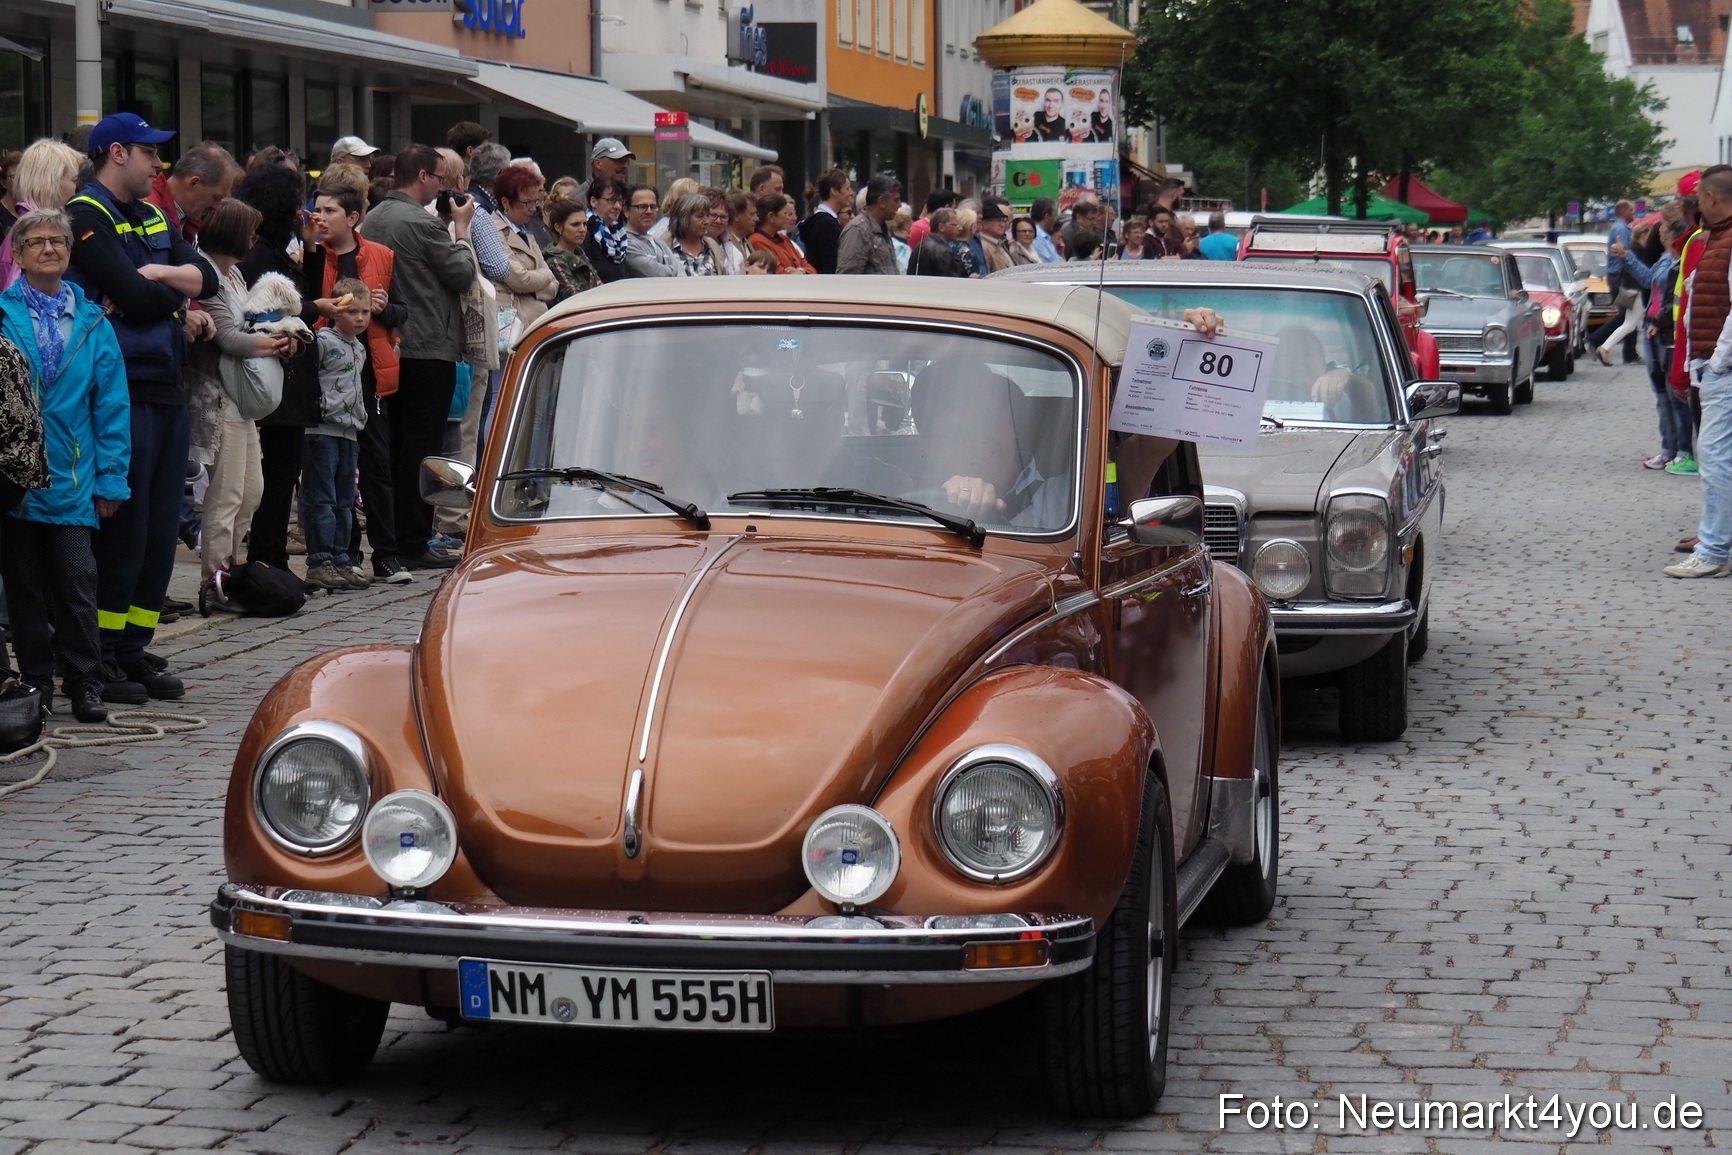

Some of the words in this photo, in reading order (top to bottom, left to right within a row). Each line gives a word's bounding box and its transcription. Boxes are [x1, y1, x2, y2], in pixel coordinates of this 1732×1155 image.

[1199, 351, 1234, 378] 80
[471, 995, 482, 1008] D
[489, 969, 547, 1016] NM
[581, 976, 640, 1021] YM
[652, 978, 768, 1024] 555H
